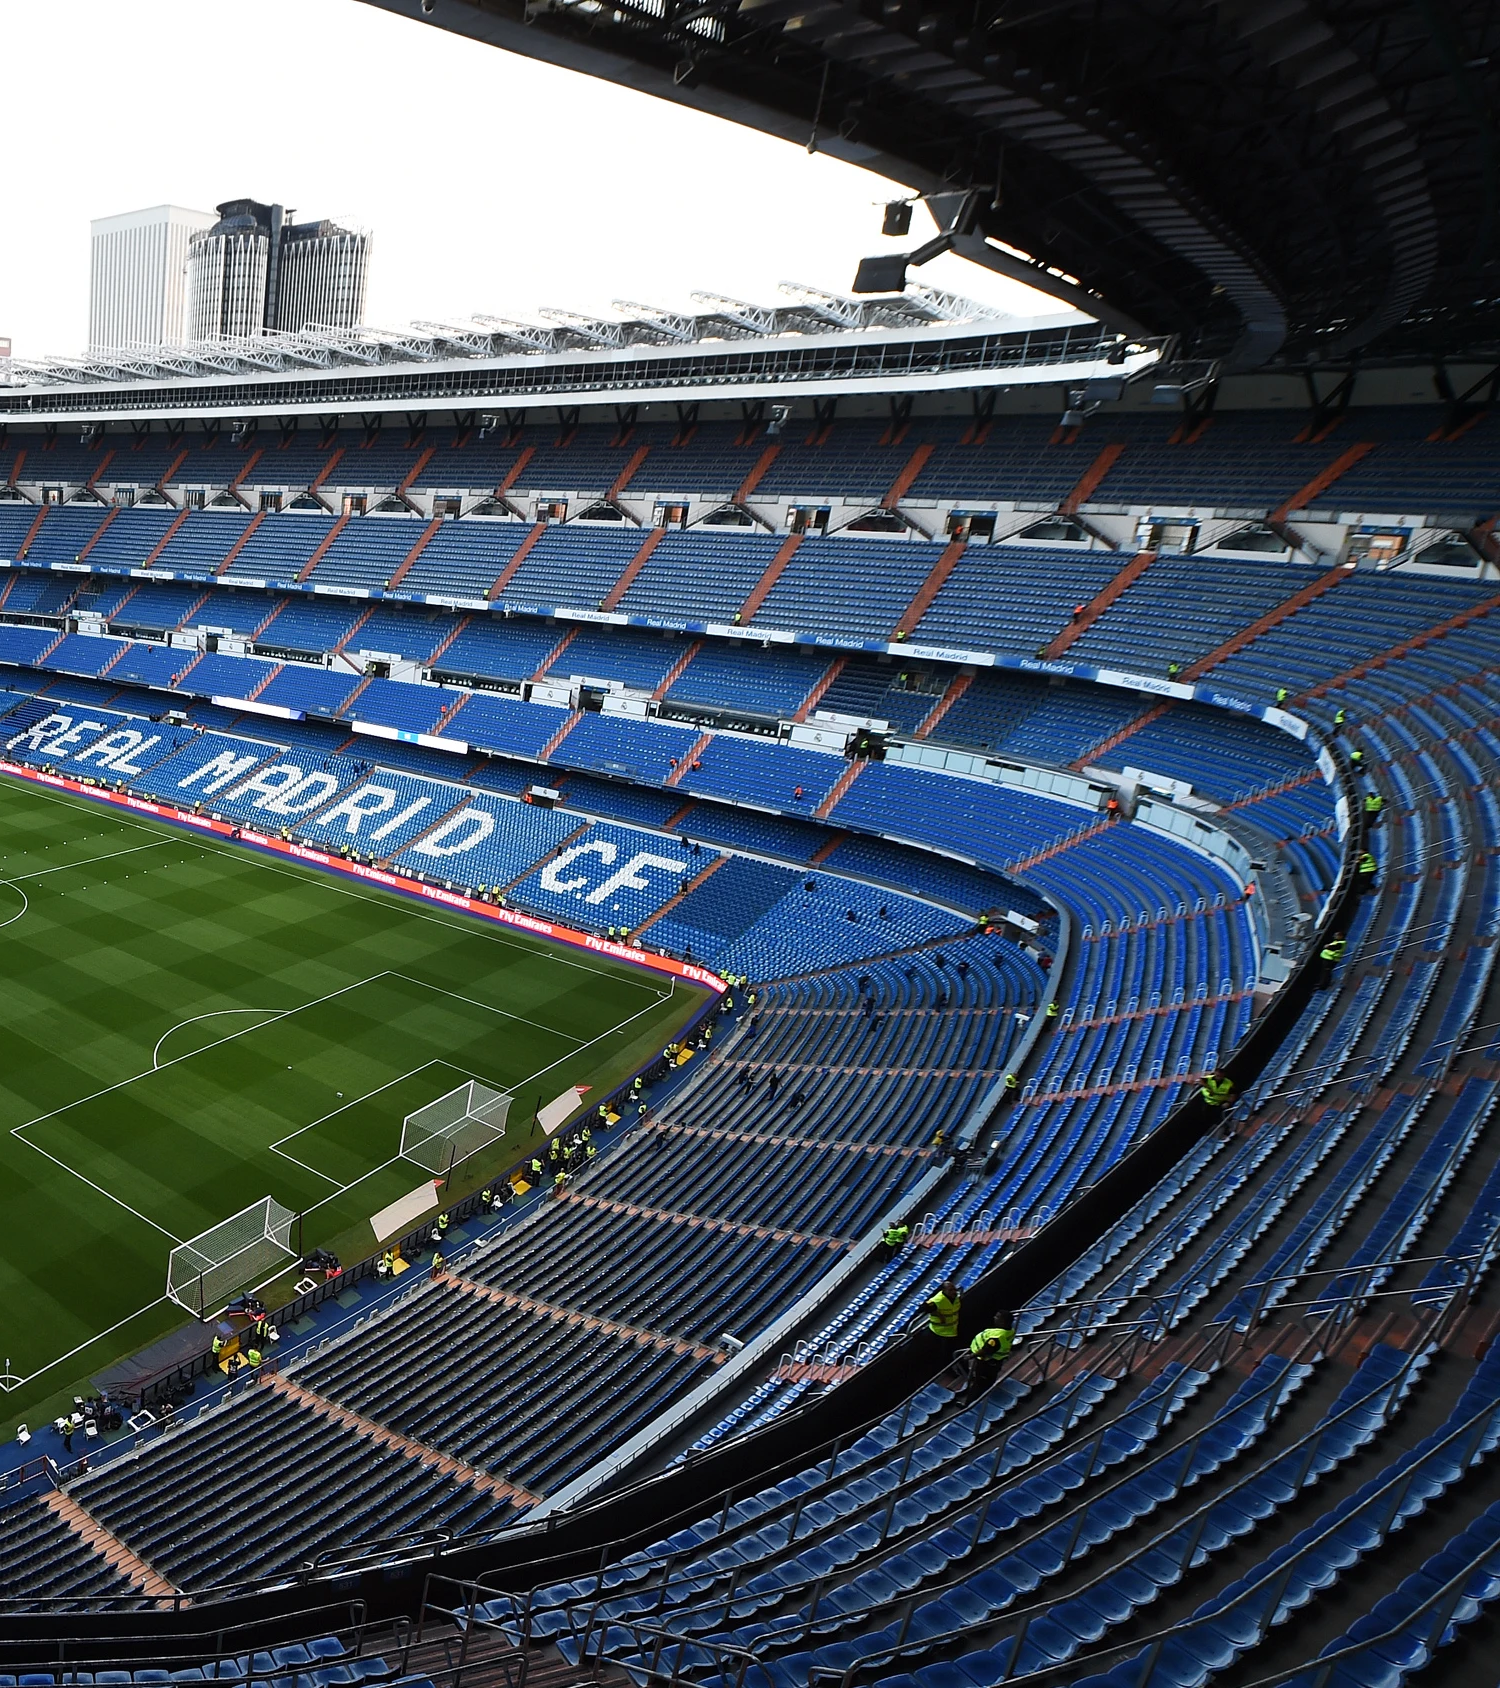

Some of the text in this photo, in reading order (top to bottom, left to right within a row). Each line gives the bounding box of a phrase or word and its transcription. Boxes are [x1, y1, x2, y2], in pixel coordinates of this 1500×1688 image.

[4, 764, 22, 774] Emirates
[8, 714, 161, 775] REAL
[178, 751, 496, 857] MADRID
[37, 772, 64, 786] Fly Emirates
[80, 784, 110, 798] Fly Emirates
[127, 796, 159, 812] Fly Emirates
[178, 812, 212, 827] Fly Emirates
[242, 830, 268, 845] Emirates
[290, 845, 329, 864] Fly Emirates
[353, 864, 396, 885] Fly Emirates
[423, 883, 470, 908] Fly Emirates
[498, 909, 552, 933] Fly Emirates
[586, 936, 645, 962] Fly Emirates
[683, 965, 700, 979] Fly
